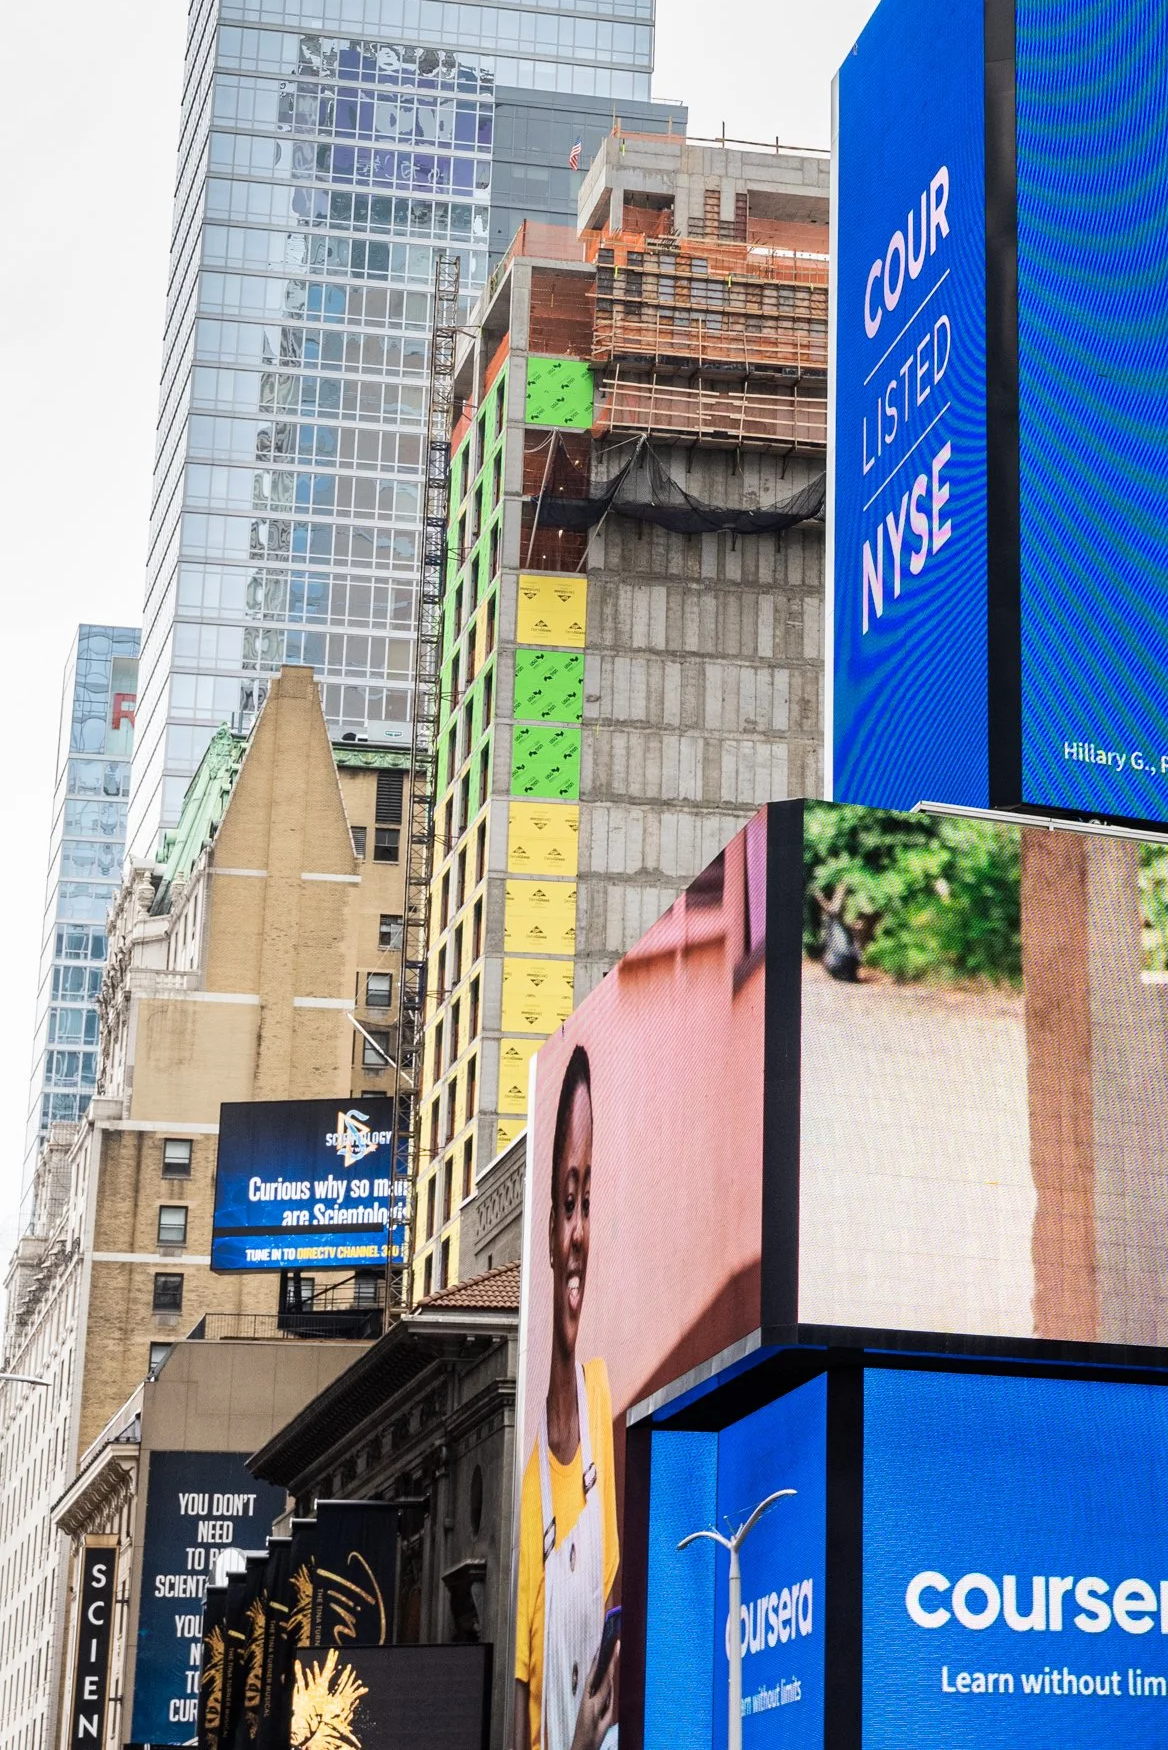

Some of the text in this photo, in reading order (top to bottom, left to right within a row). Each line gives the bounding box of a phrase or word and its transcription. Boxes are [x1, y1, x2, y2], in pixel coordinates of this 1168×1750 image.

[864, 165, 950, 339] COUR
[863, 314, 951, 477] LISTED
[862, 440, 952, 636] NYSE
[1063, 740, 1127, 772] Hillary
[248, 1175, 311, 1201] Curious
[314, 1174, 347, 1204] why
[350, 1179, 370, 1197] so
[282, 1209, 310, 1226] are
[245, 1248, 271, 1262] TUNE
[271, 1248, 283, 1261] IN
[283, 1247, 297, 1260] TO
[297, 1245, 336, 1260] DIRECTV
[337, 1244, 379, 1259] CHANNEL
[178, 1493, 257, 1517] YOU DON'T
[197, 1521, 233, 1543] NEED
[185, 1548, 206, 1570] TO
[154, 1574, 208, 1598] SCIENT
[941, 1665, 1015, 1695] Learn
[1020, 1666, 1121, 1697] without
[752, 1684, 781, 1714] without
